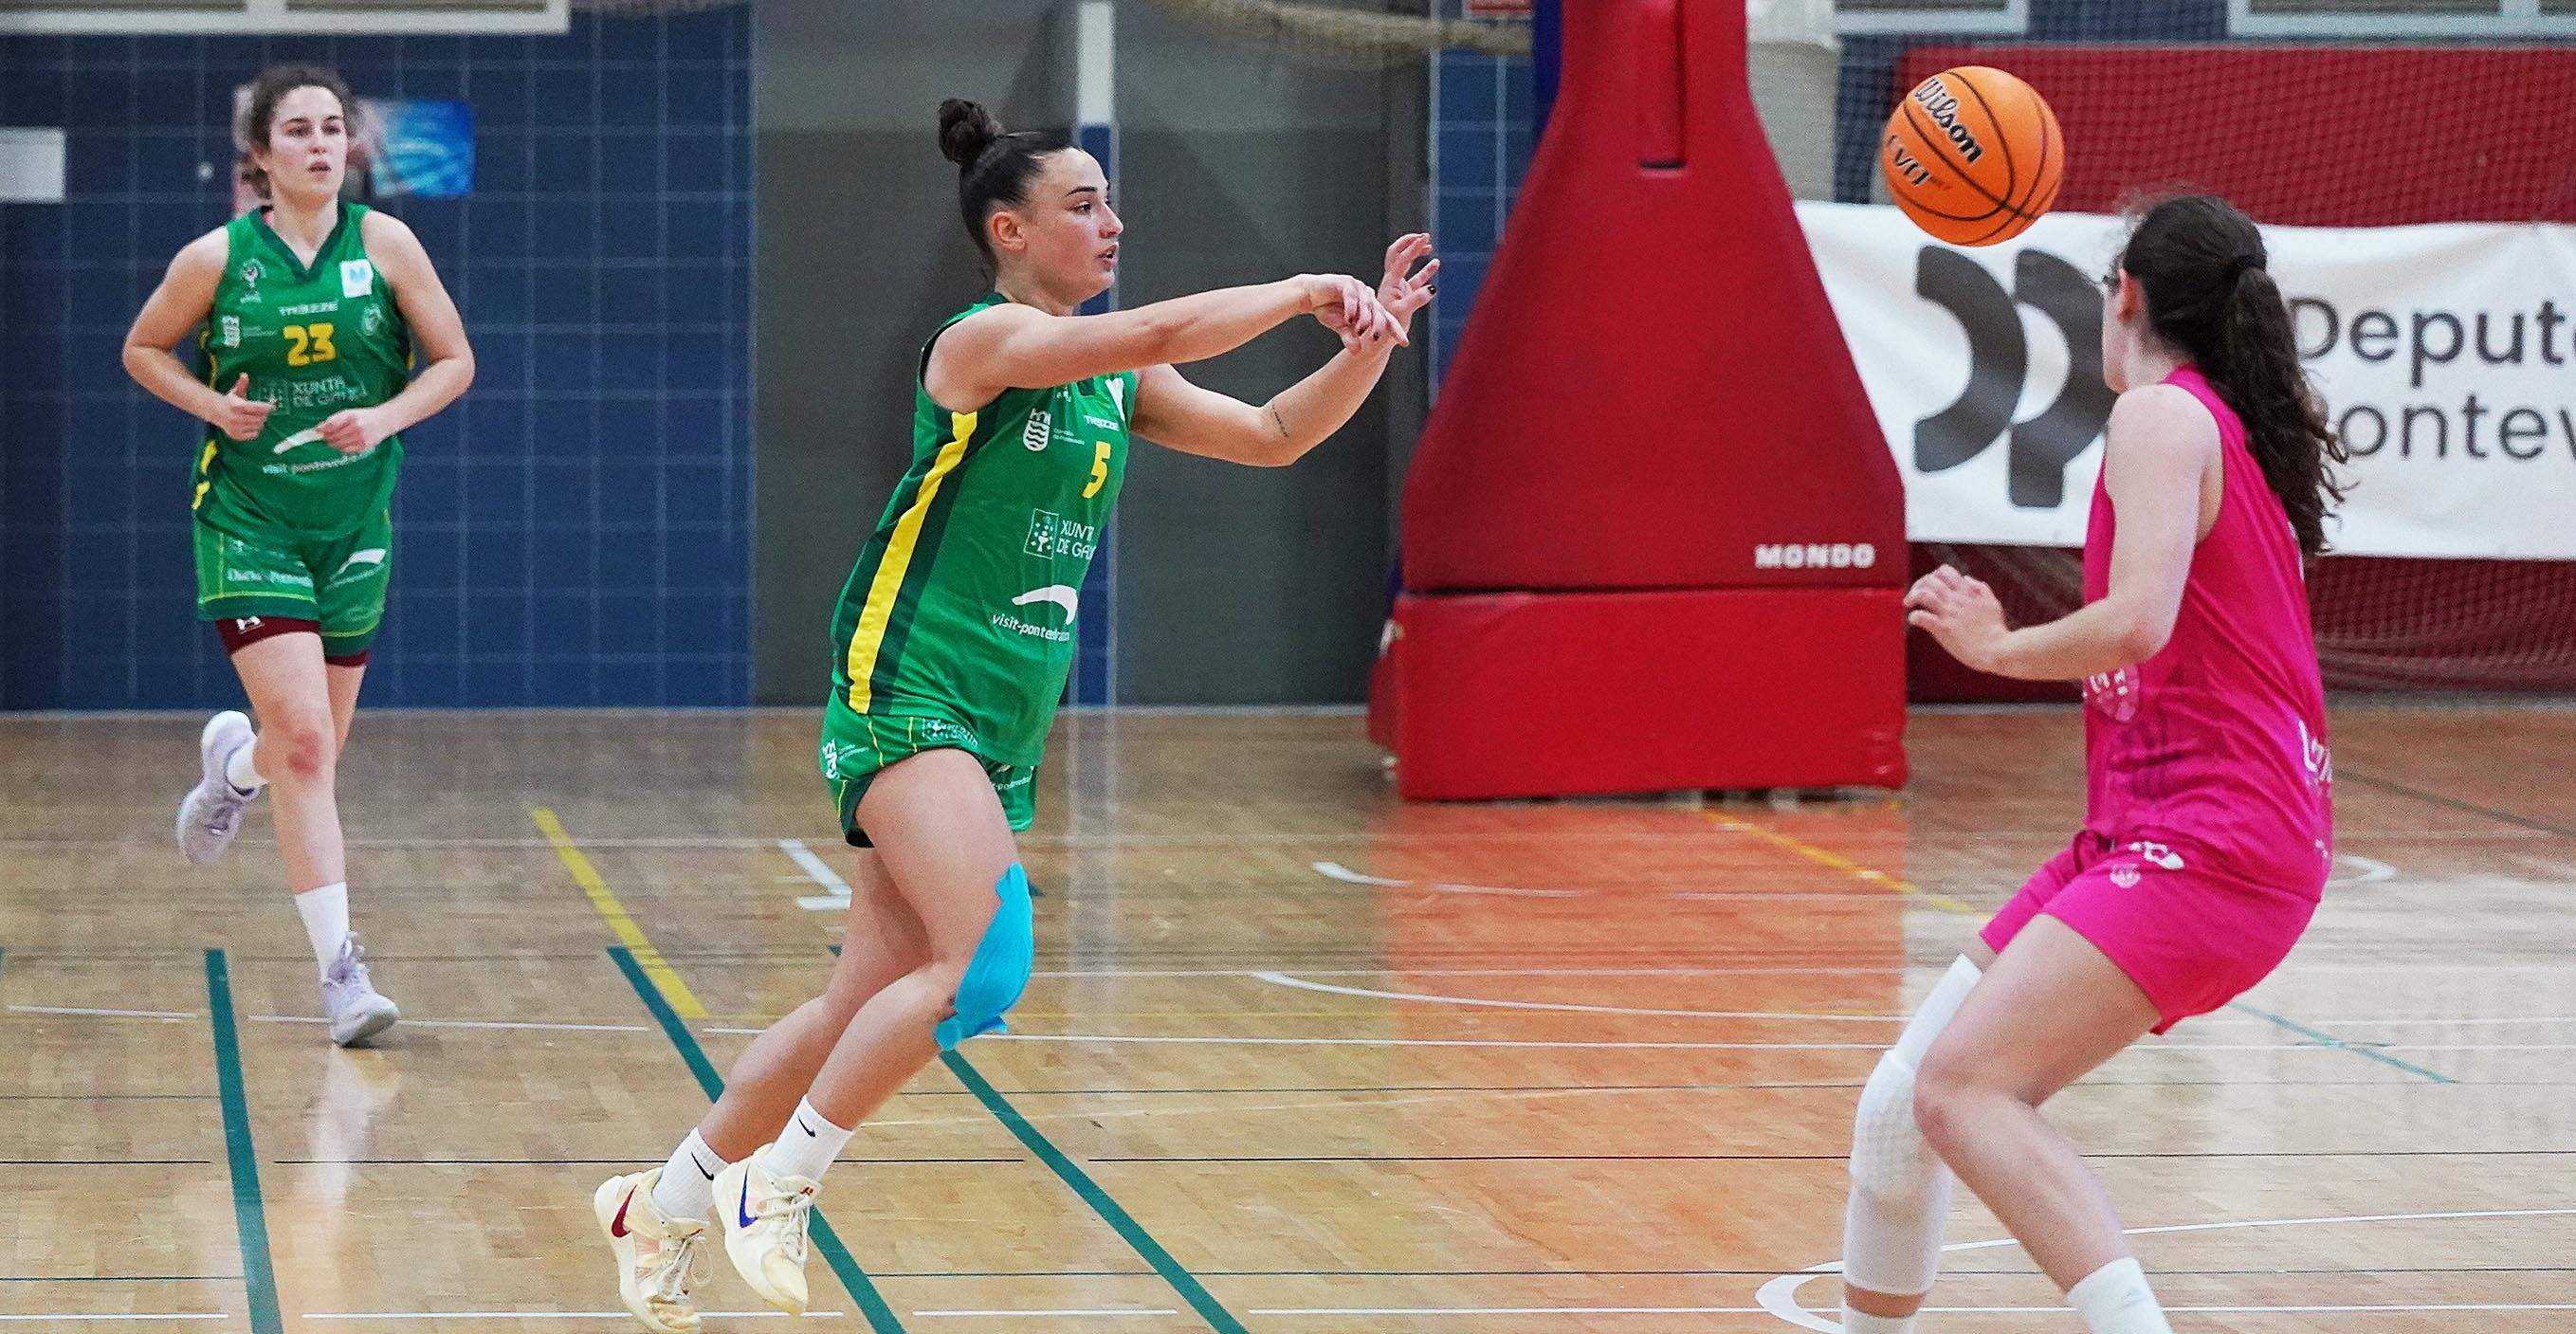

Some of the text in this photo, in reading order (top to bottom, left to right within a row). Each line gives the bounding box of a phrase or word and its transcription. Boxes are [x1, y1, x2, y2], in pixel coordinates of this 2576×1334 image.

[1914, 77, 1983, 164] Wilson
[283, 322, 337, 367] 23
[2286, 297, 2576, 389] Deput
[2337, 392, 2576, 461] onte
[1082, 441, 1111, 499] 5
[1056, 538, 1070, 555] DE
[1755, 543, 1876, 569] MONDO
